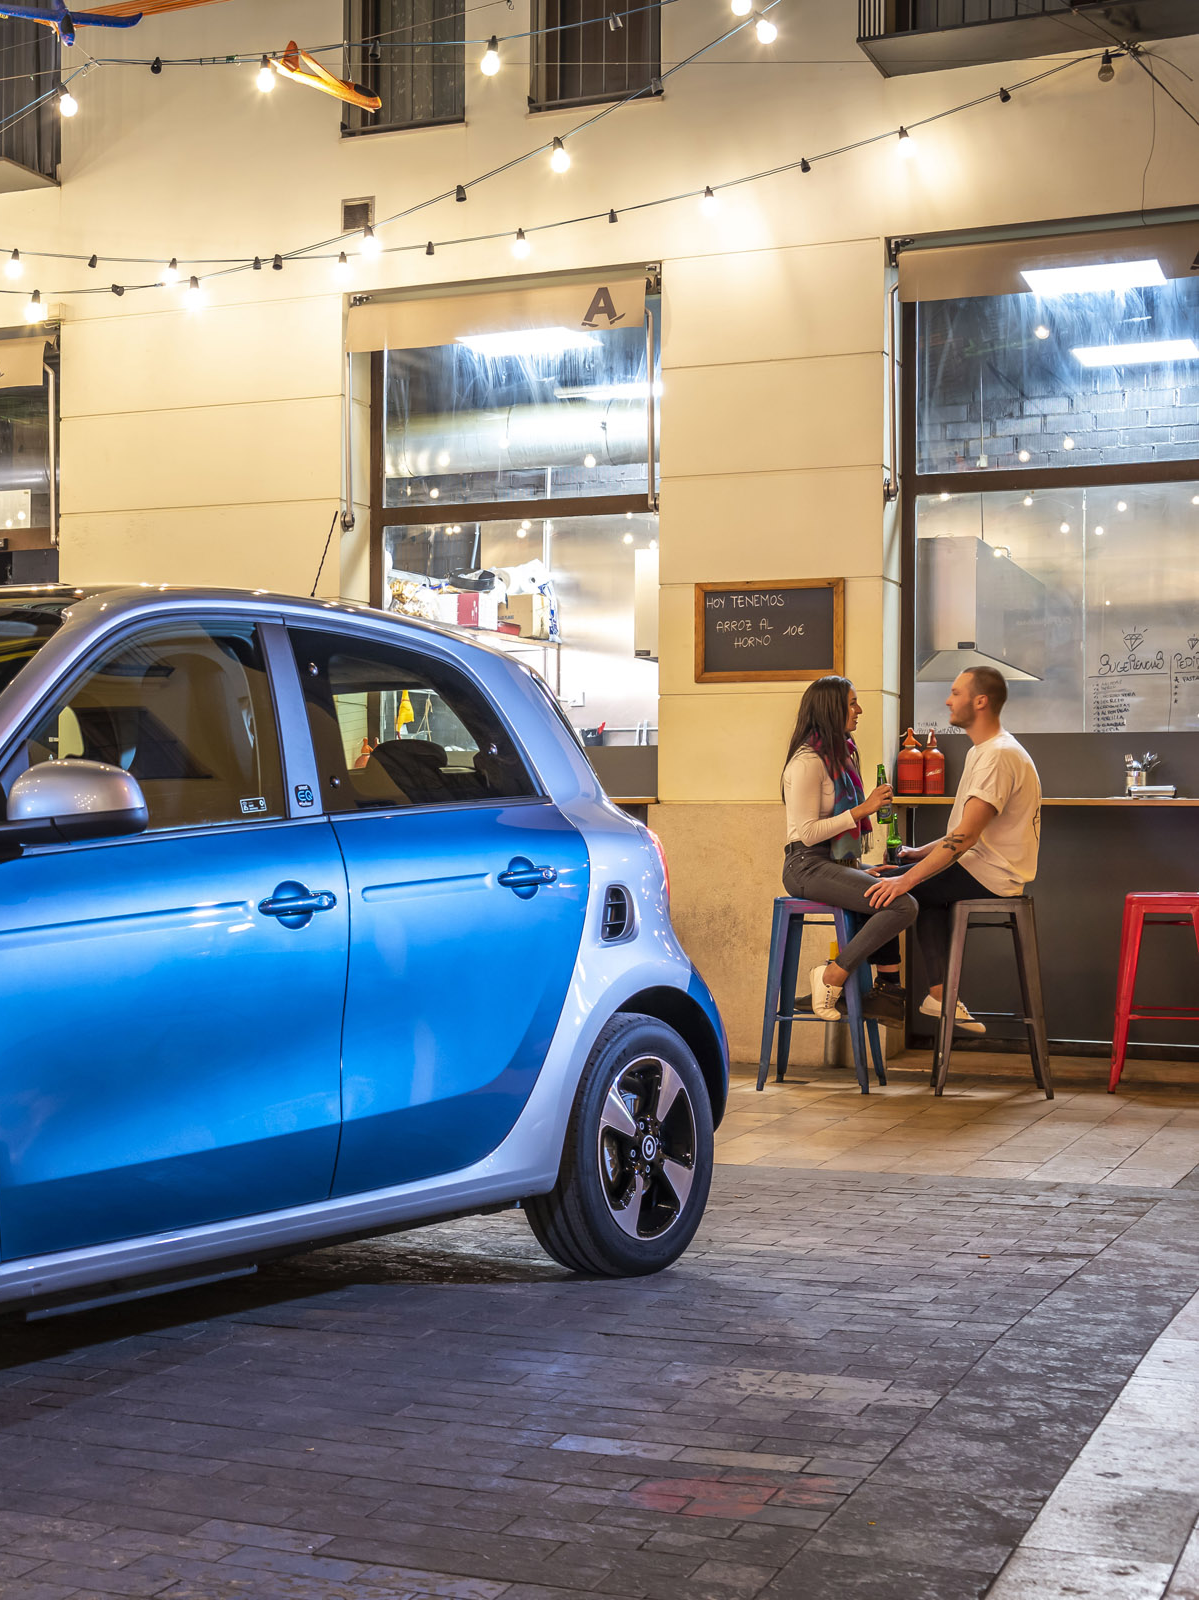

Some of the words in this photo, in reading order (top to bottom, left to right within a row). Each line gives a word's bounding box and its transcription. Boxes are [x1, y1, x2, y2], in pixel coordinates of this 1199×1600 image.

[706, 597, 725, 608] HOY
[730, 594, 785, 608] TENEMOS
[716, 620, 752, 633] ARROZ
[759, 618, 774, 631] AL
[783, 624, 805, 636] 10€
[734, 635, 772, 649] HORNO
[1098, 651, 1164, 675] SUGERENCIAS
